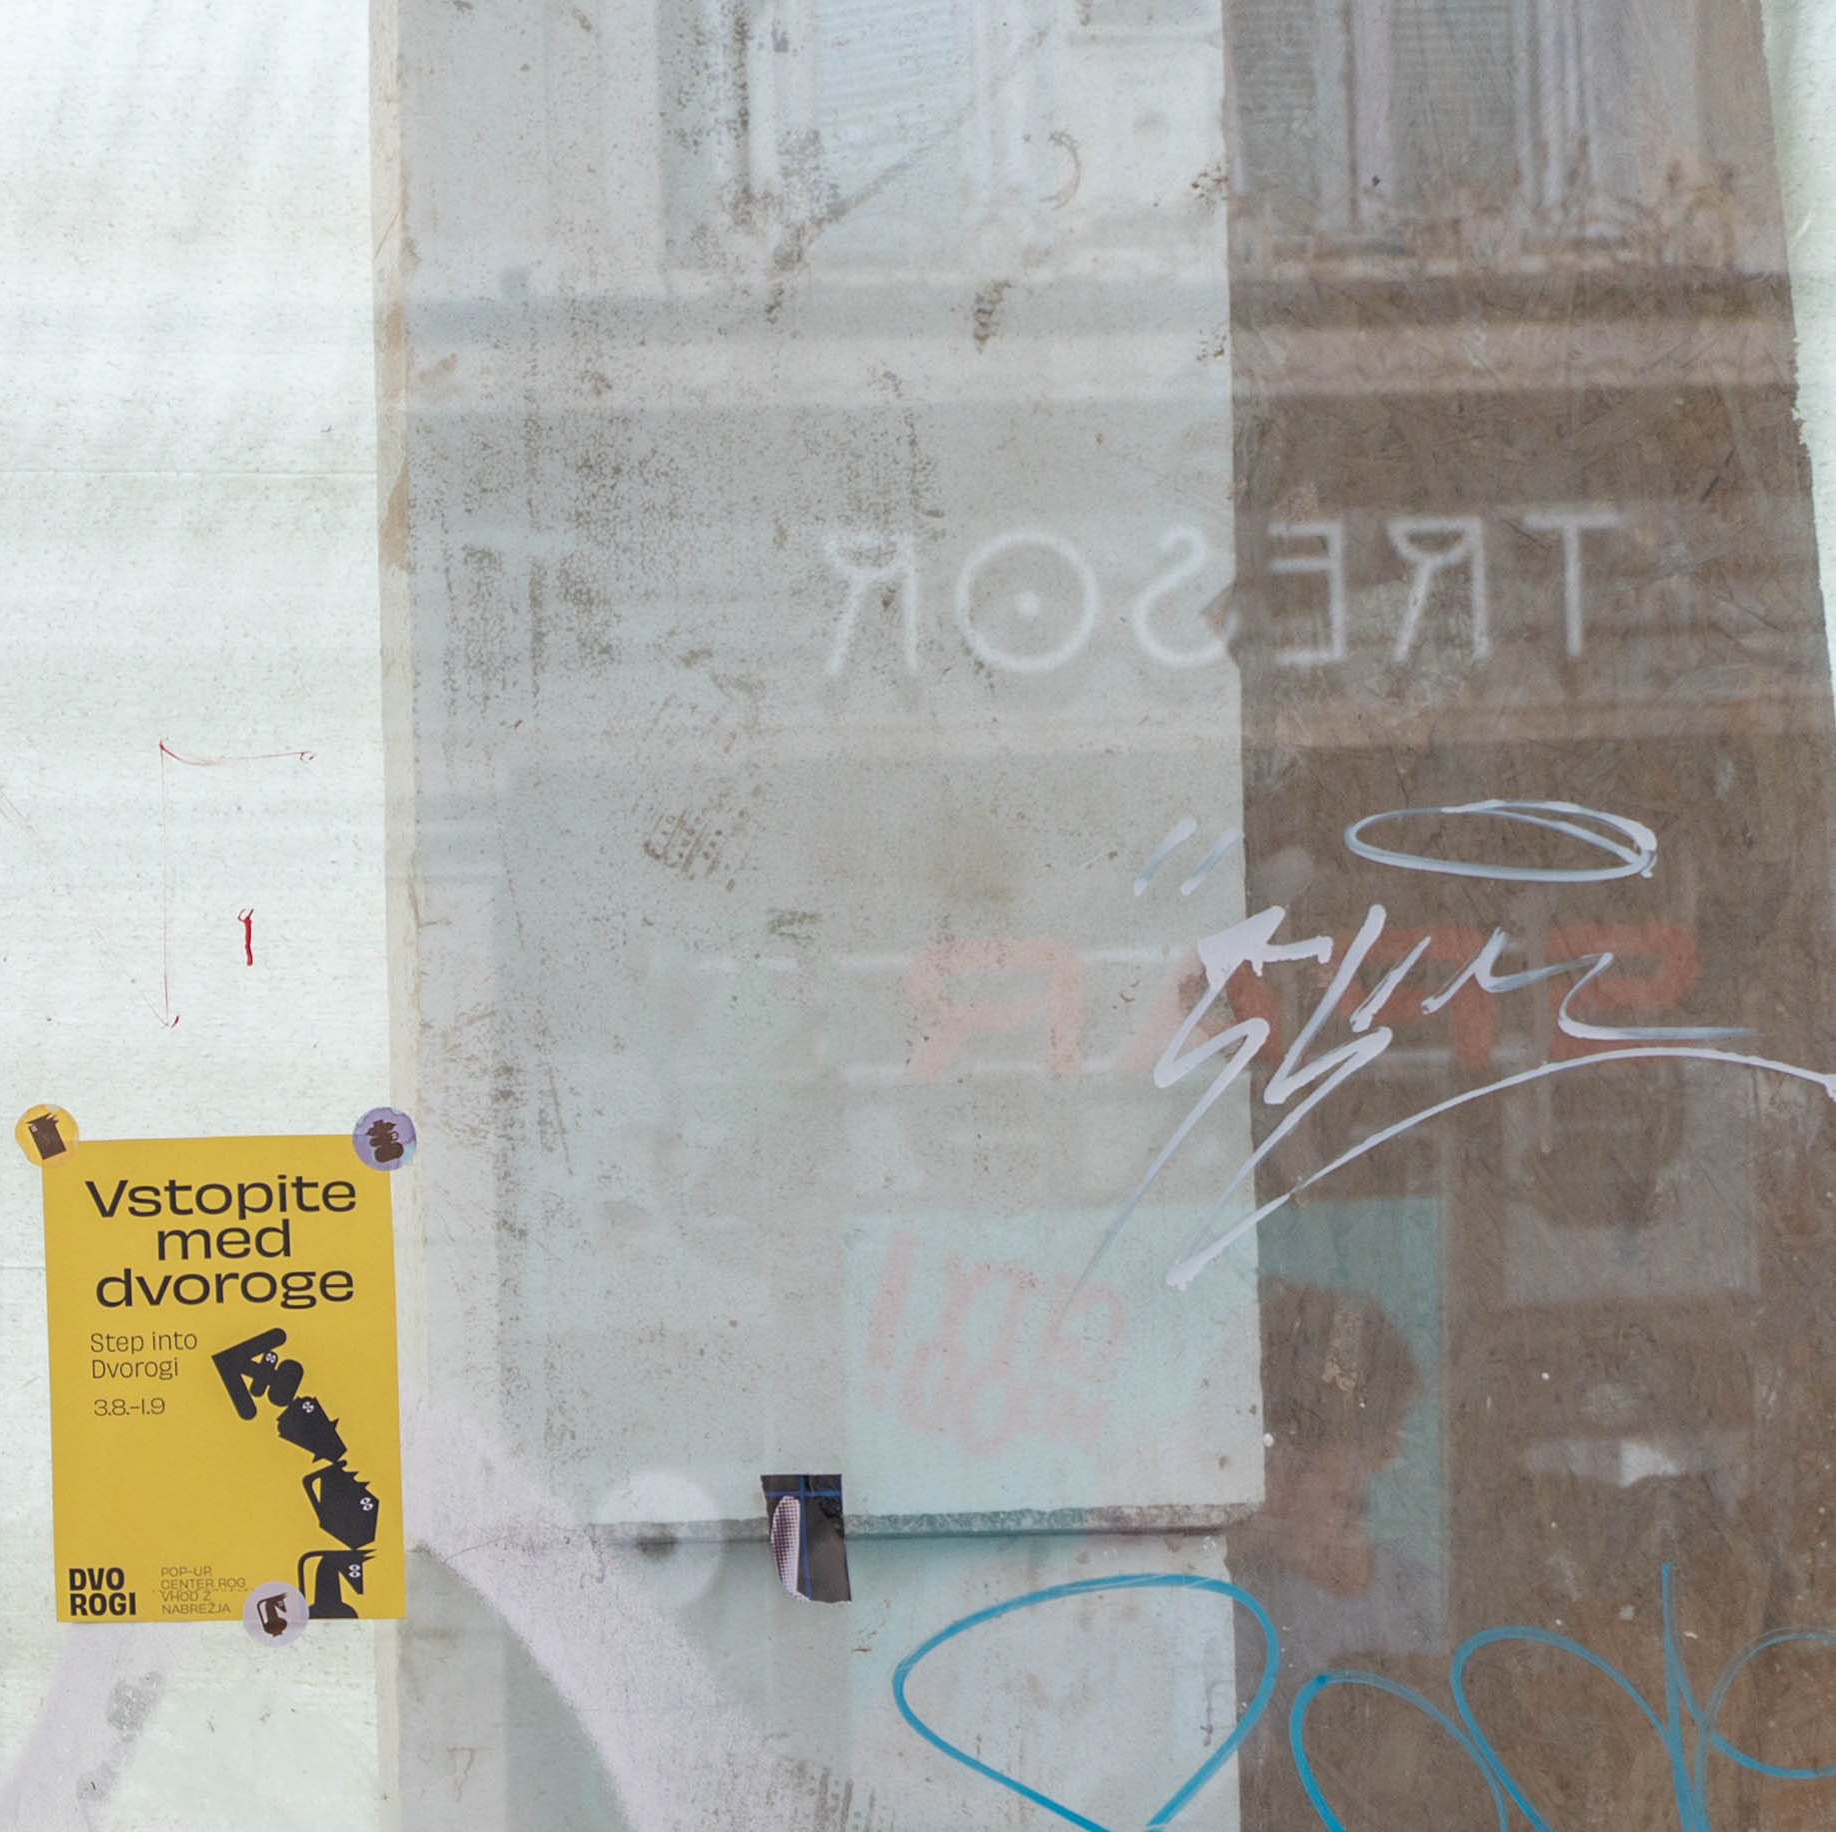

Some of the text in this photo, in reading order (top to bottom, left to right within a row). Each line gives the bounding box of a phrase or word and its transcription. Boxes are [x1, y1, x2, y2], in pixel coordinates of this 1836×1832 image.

[85, 1174, 356, 1220] Vstopite
[157, 1218, 291, 1261] med
[96, 1268, 354, 1310] dvoroge
[90, 1331, 198, 1354] Step into
[92, 1357, 178, 1381] Dvorogi
[69, 1567, 125, 1591] DVO
[218, 1577, 247, 1589] ROG
[70, 1592, 136, 1617] ROGI
